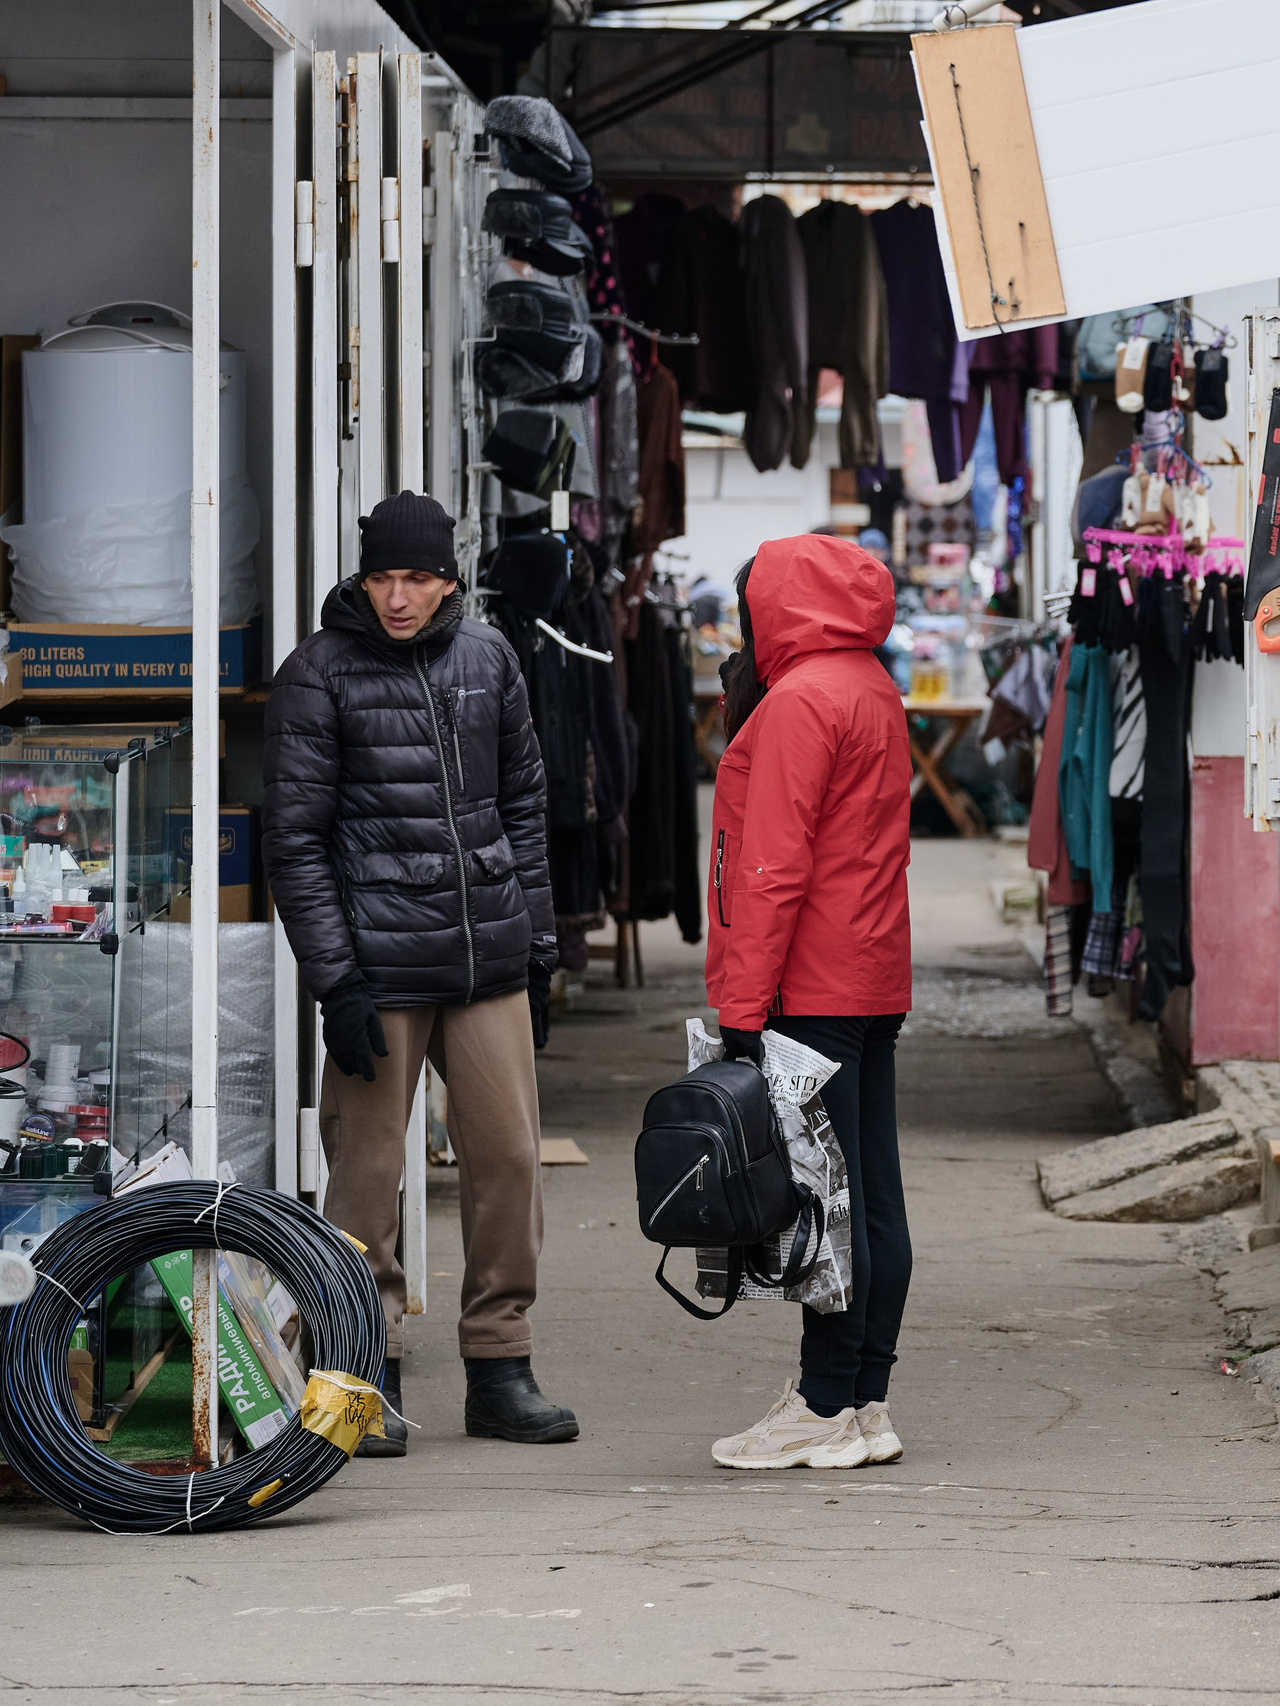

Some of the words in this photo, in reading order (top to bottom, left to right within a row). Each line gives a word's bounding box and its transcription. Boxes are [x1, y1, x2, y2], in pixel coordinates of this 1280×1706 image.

[40, 647, 85, 661] LITERS
[22, 664, 51, 678] HIGH
[55, 663, 111, 679] QUALITY
[115, 663, 128, 677] IN
[132, 663, 175, 677] EVERY
